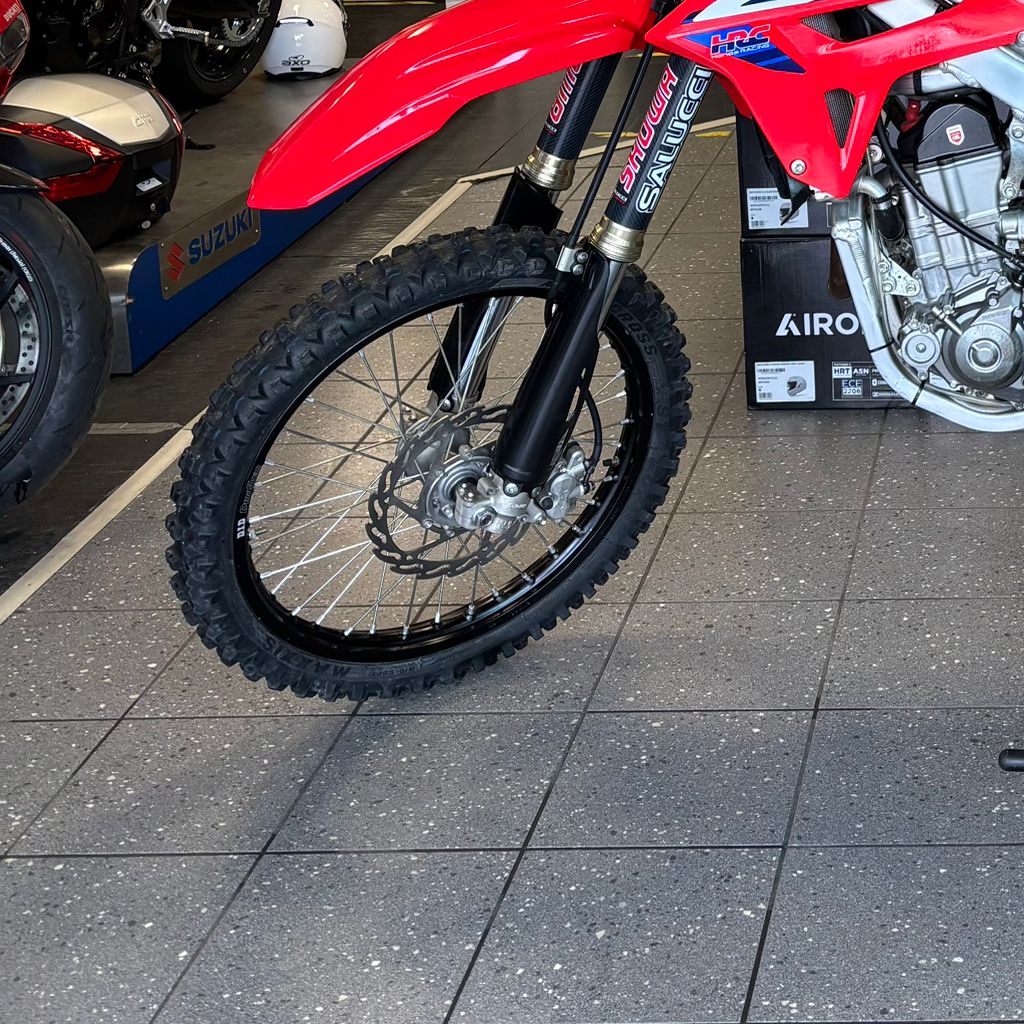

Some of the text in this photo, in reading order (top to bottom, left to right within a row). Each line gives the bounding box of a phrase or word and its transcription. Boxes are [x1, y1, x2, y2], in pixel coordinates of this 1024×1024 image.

[4, 3, 20, 22] DUCATI
[711, 24, 771, 54] HRC
[711, 43, 770, 59] HONDA RACING
[619, 63, 679, 194] SHOWA
[188, 207, 255, 266] SUZUKI
[775, 313, 864, 336] AIRO
[853, 367, 869, 375] ASN
